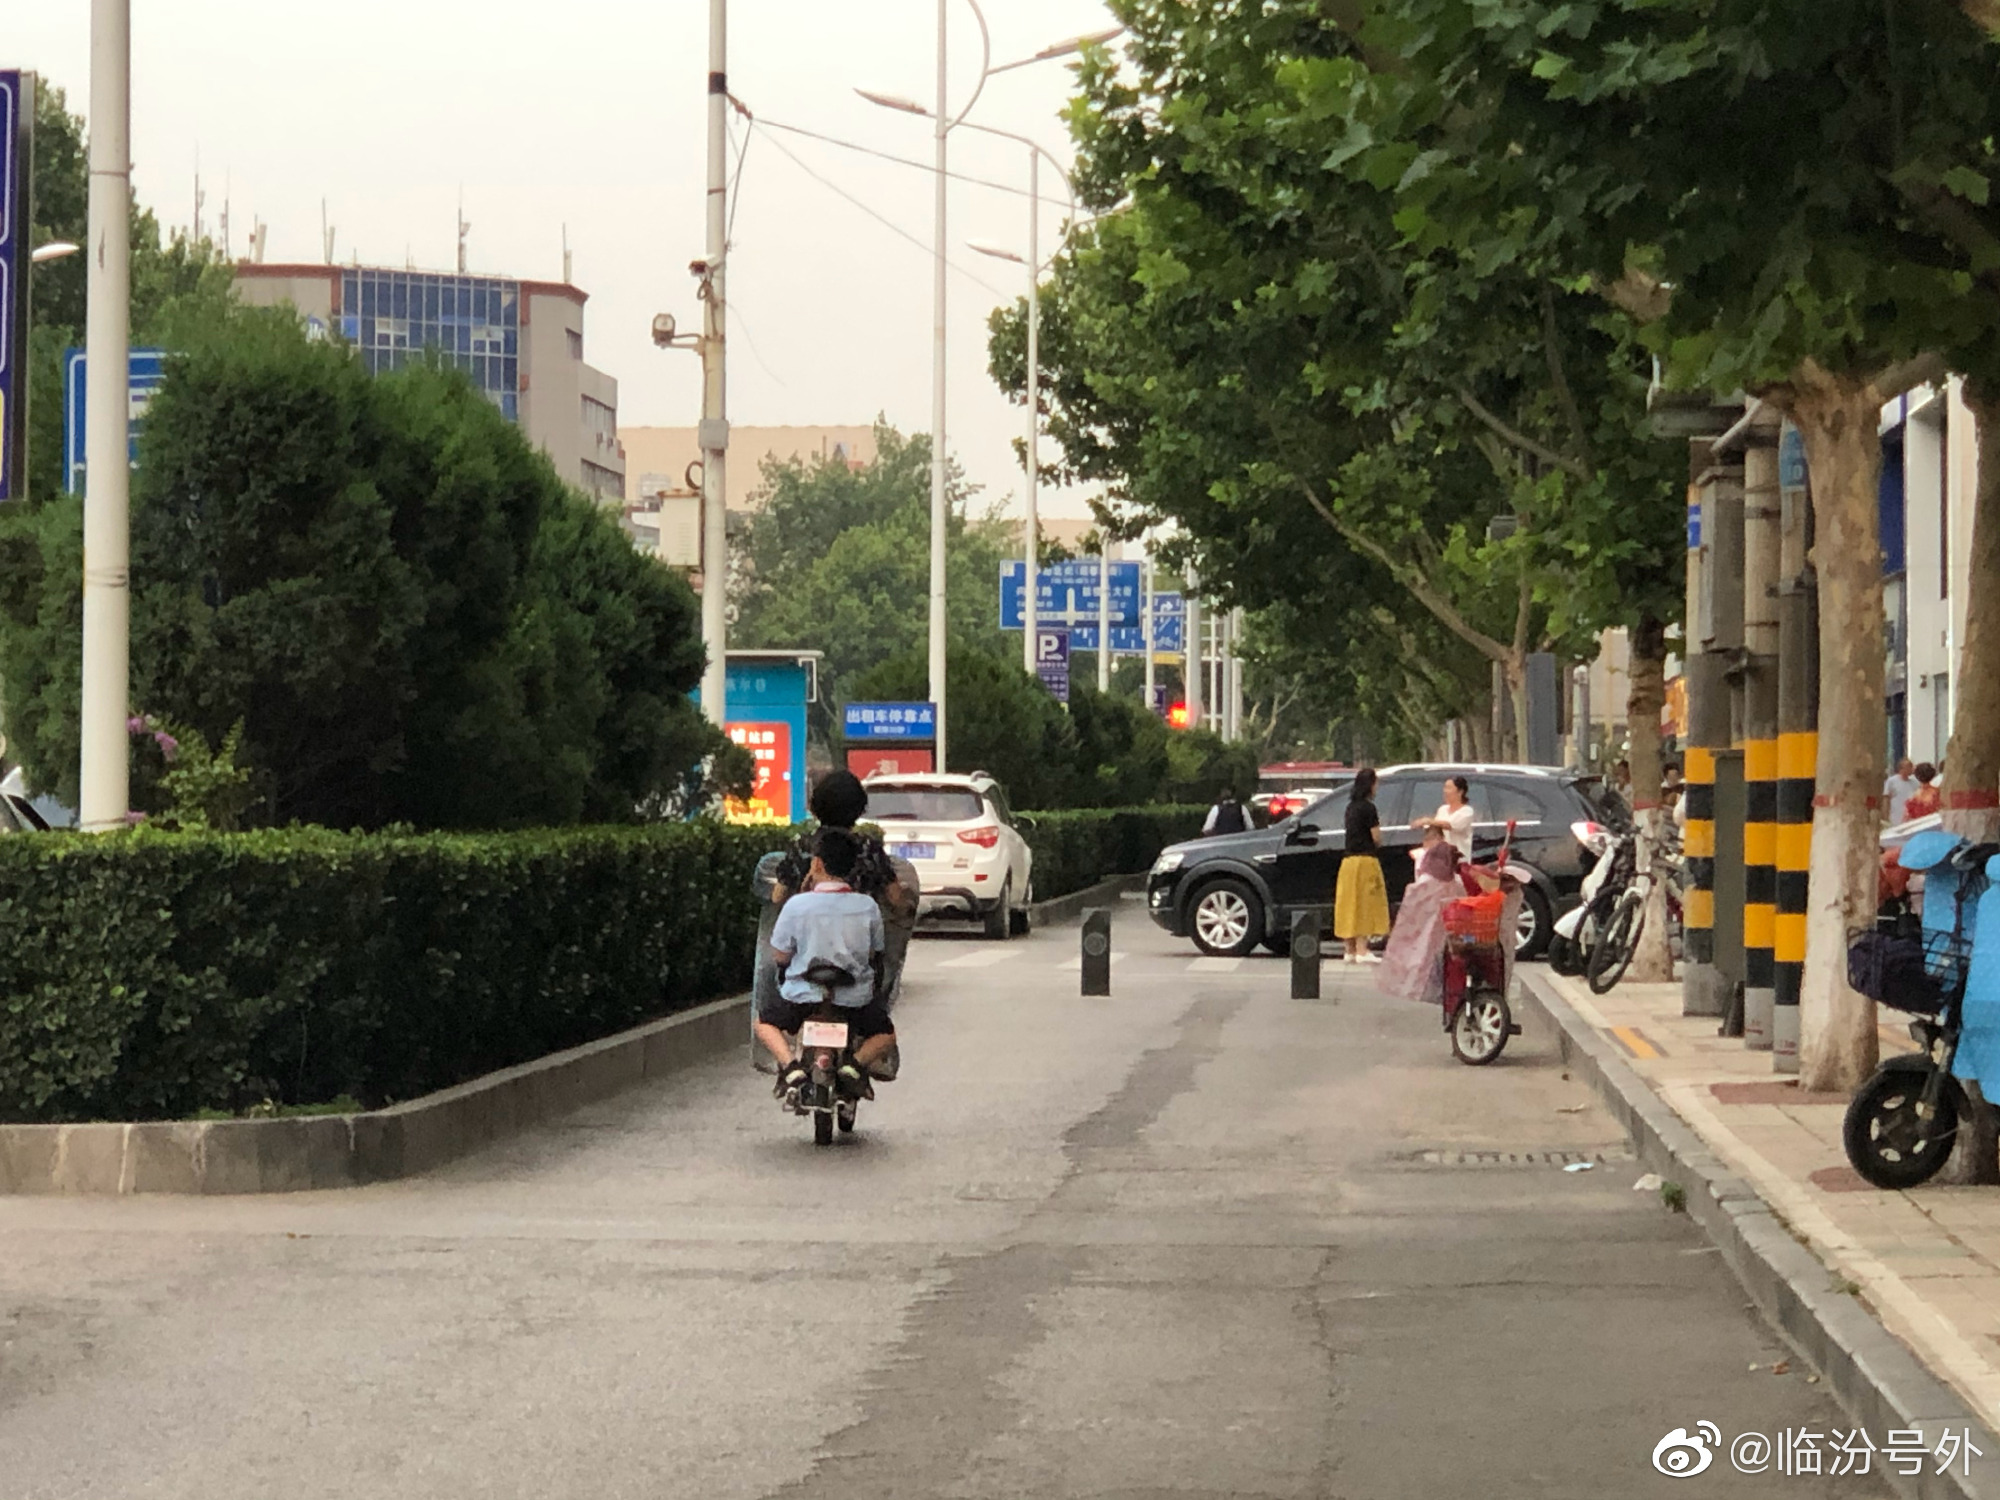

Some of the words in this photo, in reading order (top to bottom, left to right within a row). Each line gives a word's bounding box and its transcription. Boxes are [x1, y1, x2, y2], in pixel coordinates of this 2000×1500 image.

[1039, 634, 1060, 661] P
[846, 709, 932, 723] 出租车停靠点
